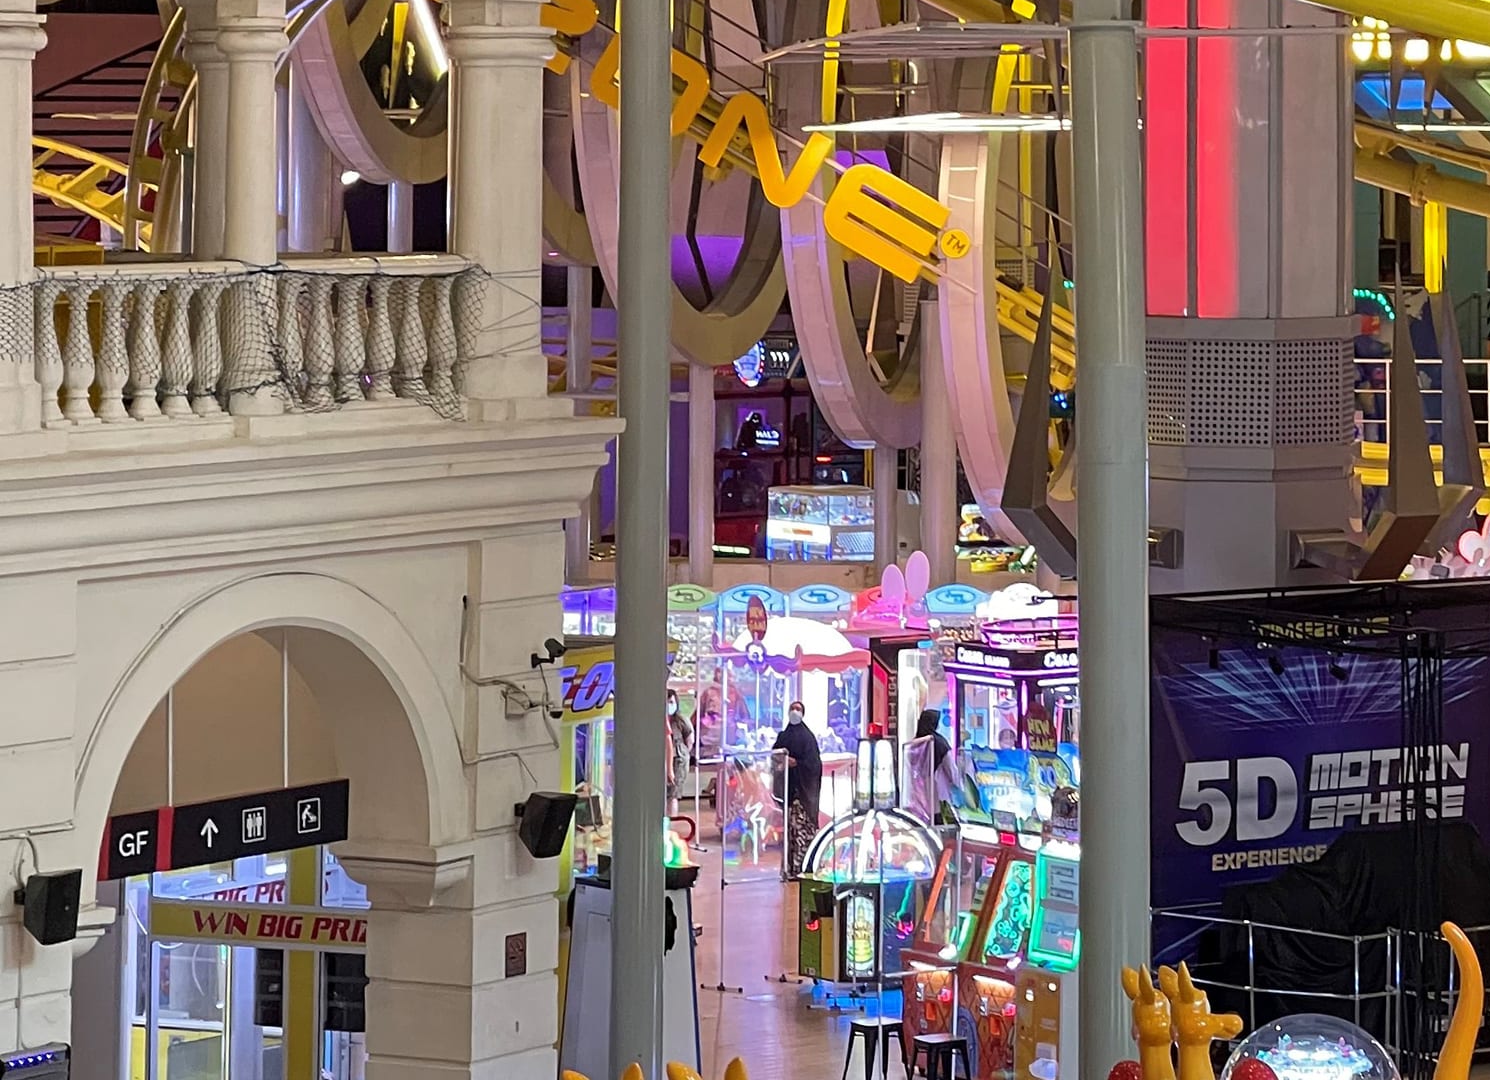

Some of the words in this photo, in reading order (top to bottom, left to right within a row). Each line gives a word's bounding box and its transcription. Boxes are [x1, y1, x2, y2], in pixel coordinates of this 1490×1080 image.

[1044, 651, 1078, 668] COLO
[1309, 742, 1469, 792] MOTION
[1175, 756, 1297, 846] 5D
[118, 830, 150, 857] GF
[255, 880, 285, 904] PR
[193, 910, 249, 935] WIN
[257, 914, 303, 939] BIG
